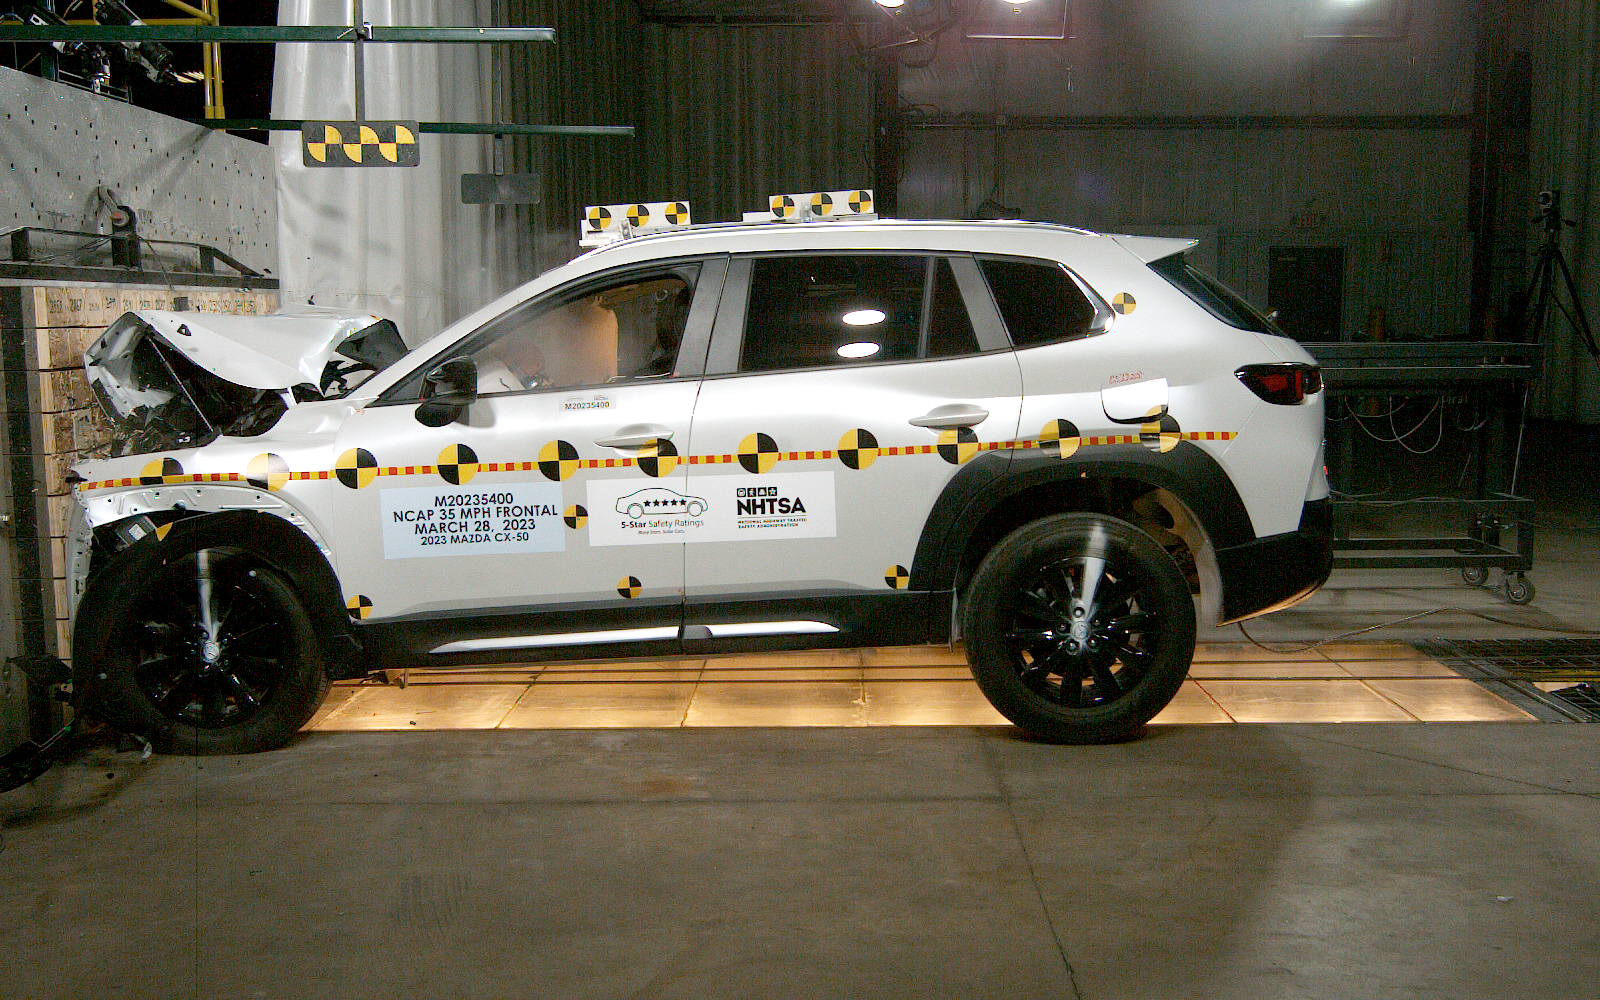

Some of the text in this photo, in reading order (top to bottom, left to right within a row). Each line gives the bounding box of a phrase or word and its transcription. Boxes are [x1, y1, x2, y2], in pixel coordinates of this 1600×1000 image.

[434, 493, 513, 507] M20235400
[737, 497, 806, 515] NHTSA
[393, 505, 558, 522] NCAP 35 MPH FRONTAL
[415, 518, 536, 534] MARCH 28, 2023
[621, 518, 705, 529] 5-Star Safety Ratings
[420, 531, 529, 545] 2023 MAZDA CX-50
